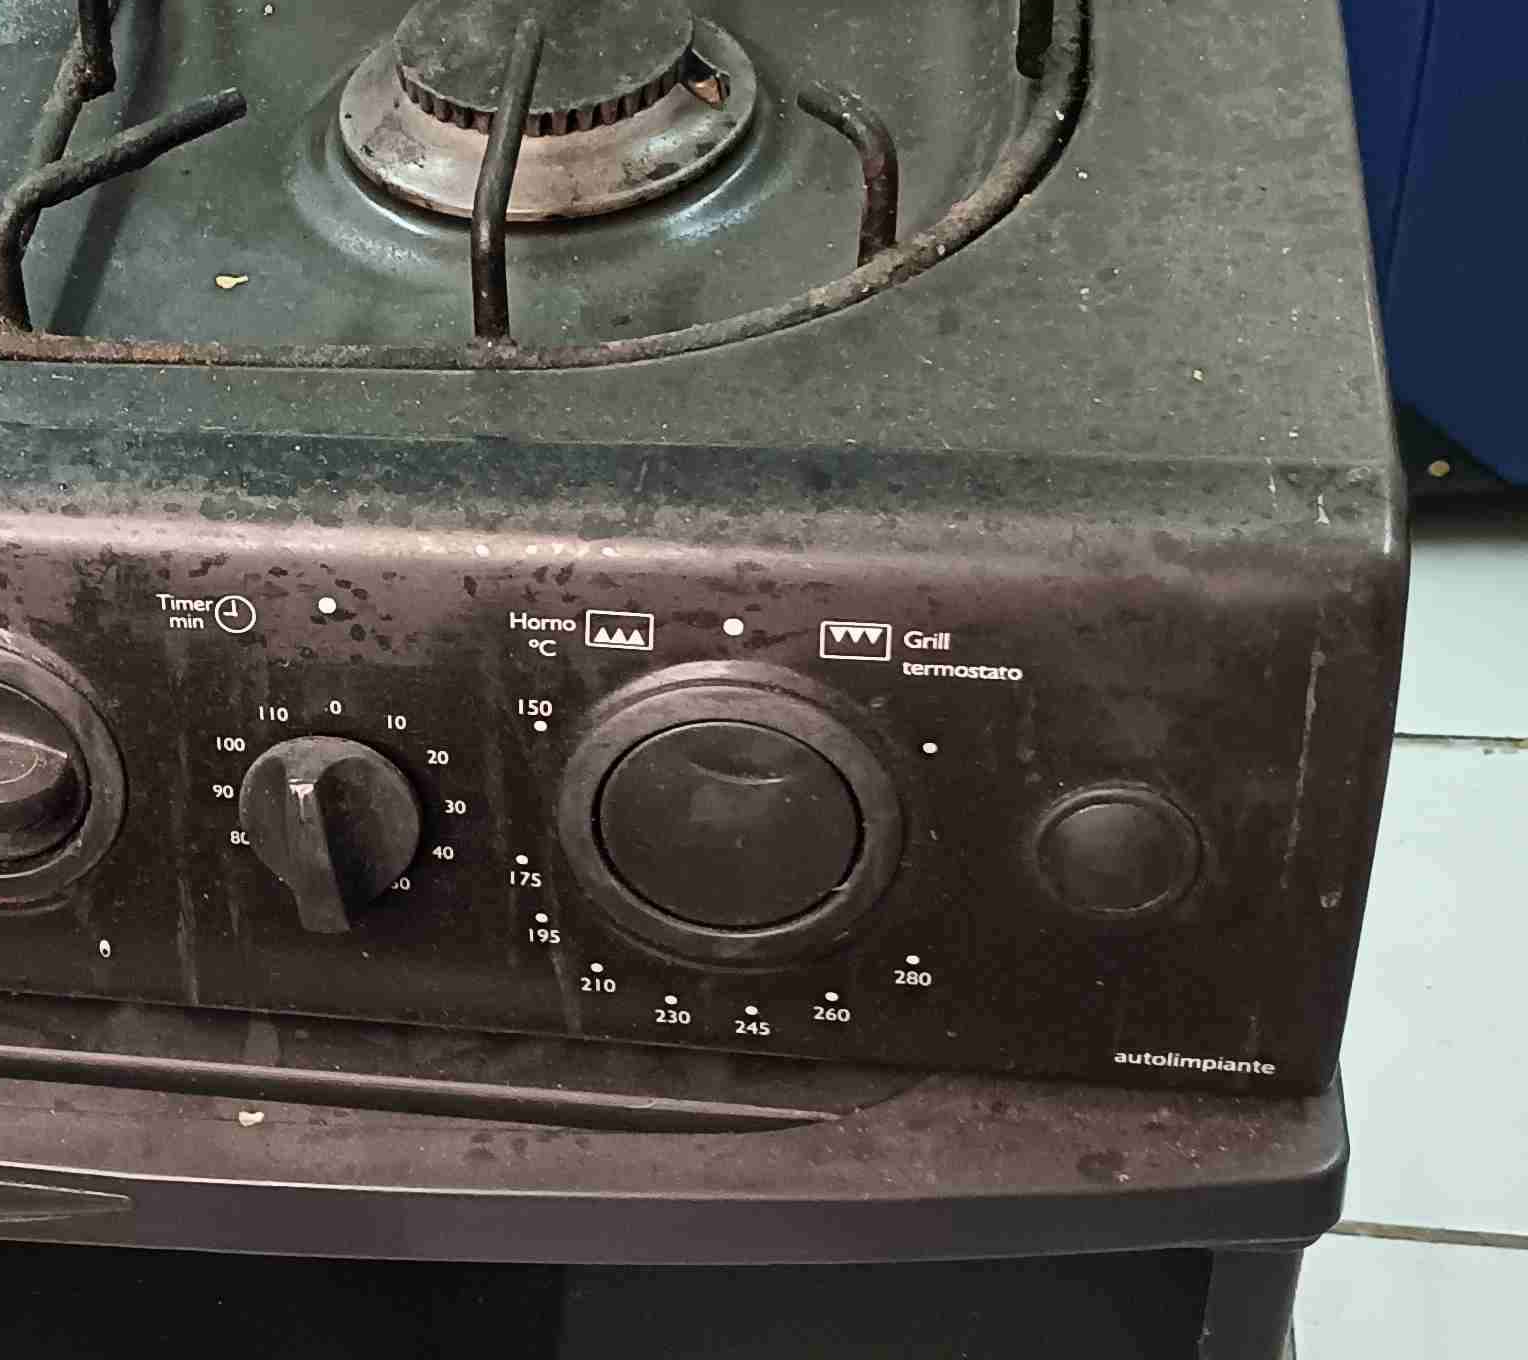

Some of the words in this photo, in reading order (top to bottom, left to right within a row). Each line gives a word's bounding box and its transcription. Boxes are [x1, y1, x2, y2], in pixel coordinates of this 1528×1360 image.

[155, 592, 214, 613] Timer
[169, 612, 205, 629] min
[509, 611, 577, 632] Horno
[528, 638, 557, 657] °C
[903, 630, 951, 650] Grill
[902, 660, 1023, 681] termostato
[259, 705, 289, 722] 110
[329, 700, 342, 715] 0
[518, 698, 553, 717] 150
[387, 714, 407, 730] 10
[216, 736, 246, 752] 100
[426, 749, 449, 765] 20
[212, 784, 234, 799] 90
[444, 799, 467, 815] 30
[432, 845, 454, 860] 40
[510, 870, 542, 888] 175
[528, 928, 561, 944] 195
[580, 976, 616, 993] 210
[894, 970, 932, 986] 280
[655, 1009, 691, 1025] 230
[813, 1006, 851, 1022] 260
[735, 1020, 771, 1036] 245
[1114, 1052, 1276, 1075] autolimpiante
